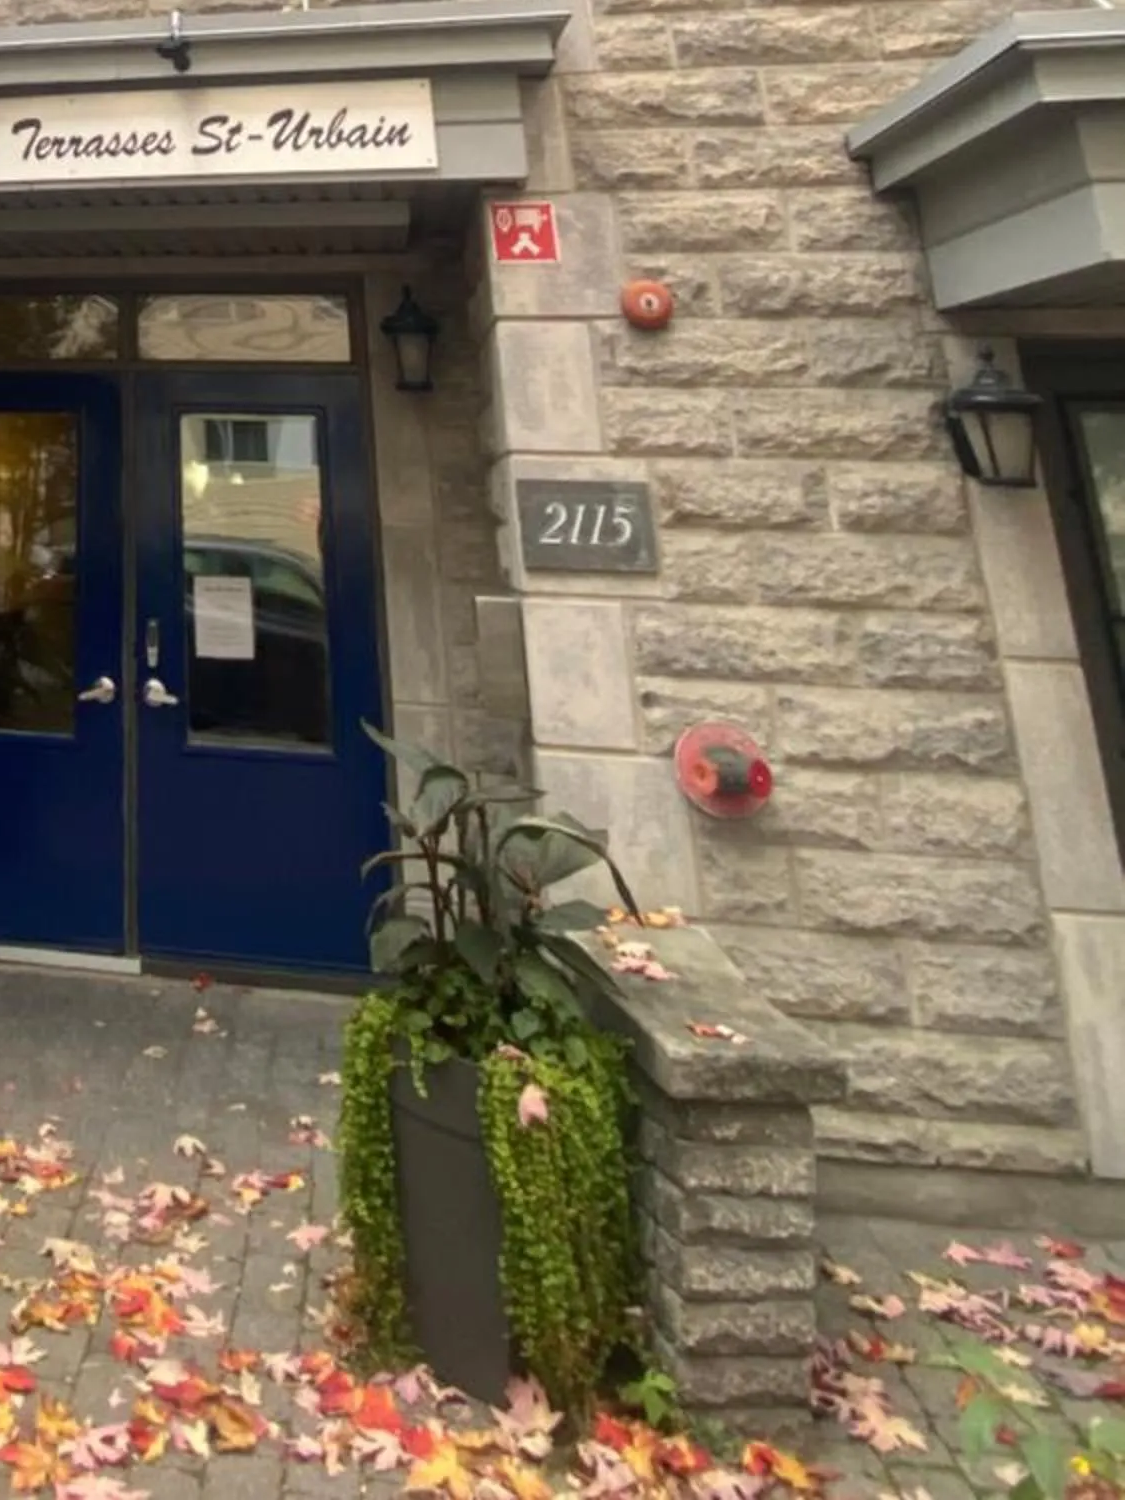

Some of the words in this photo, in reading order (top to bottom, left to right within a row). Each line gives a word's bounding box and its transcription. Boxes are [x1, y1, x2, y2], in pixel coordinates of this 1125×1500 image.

[11, 117, 176, 161] Terrasses
[190, 106, 412, 155] St-Urbain
[539, 501, 636, 546] 2115
